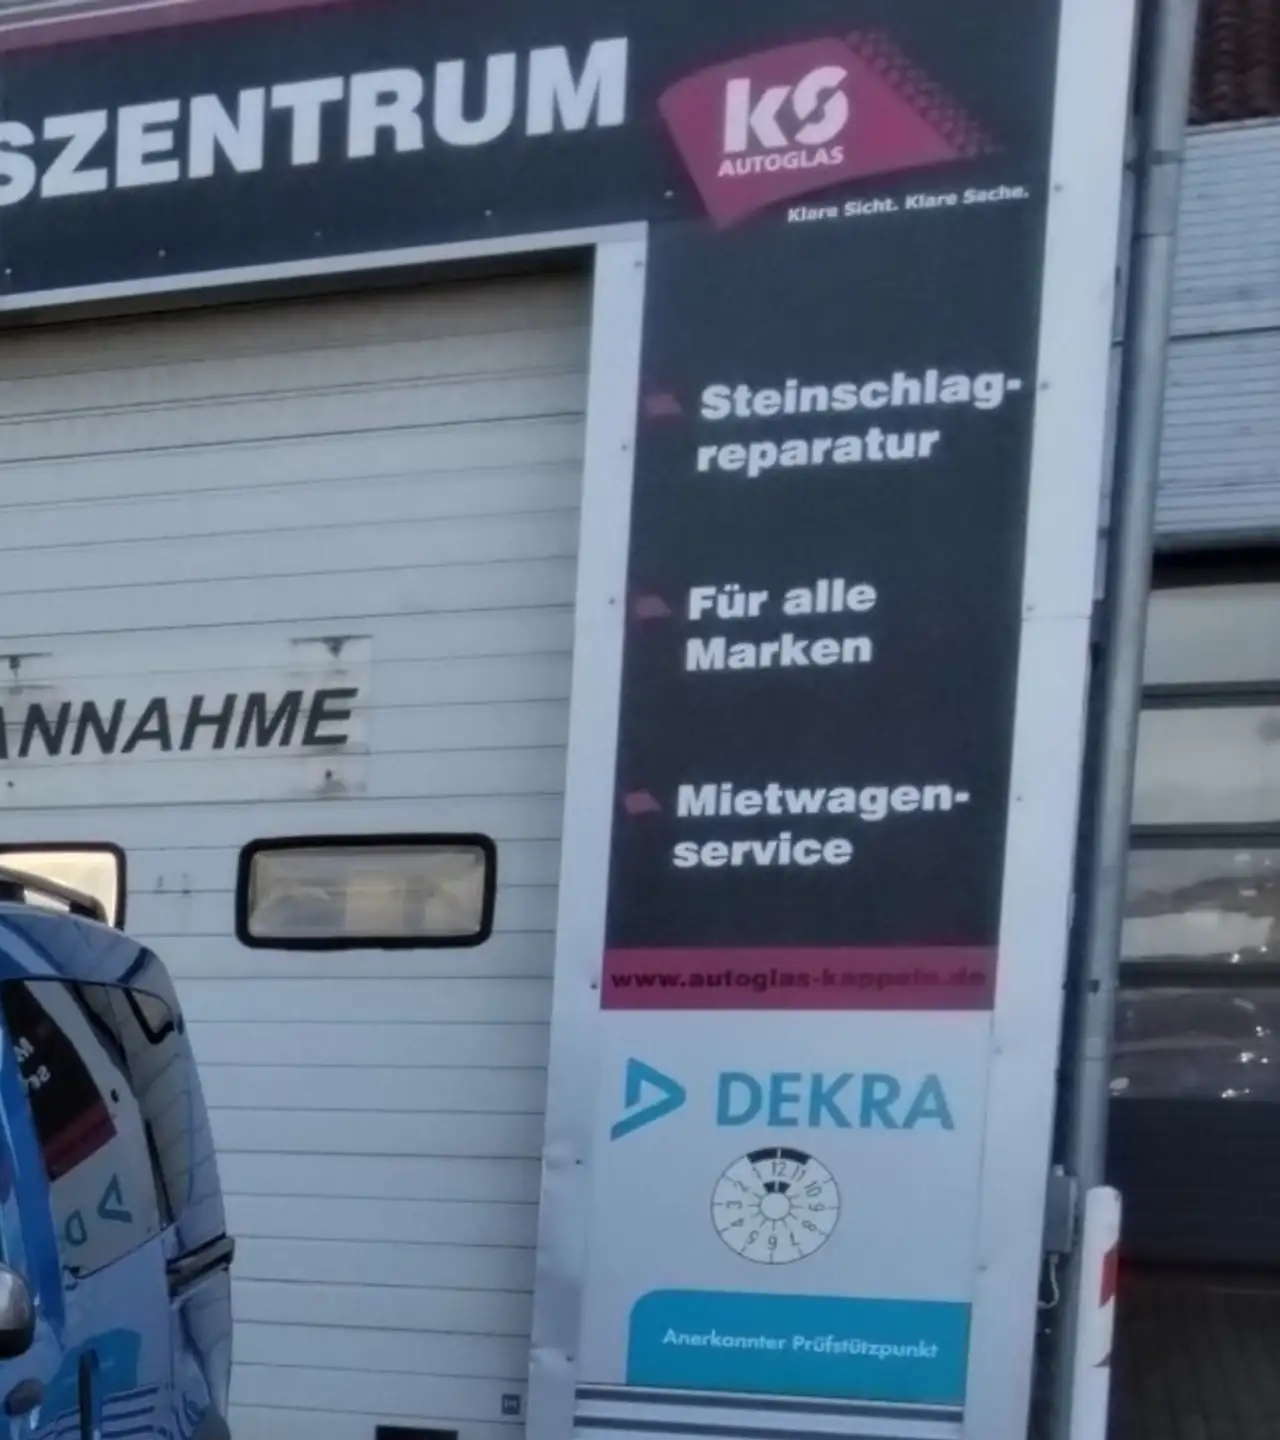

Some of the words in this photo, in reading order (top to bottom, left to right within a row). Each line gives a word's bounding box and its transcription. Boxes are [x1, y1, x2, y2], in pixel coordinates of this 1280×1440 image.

[717, 145, 845, 178] AUTOGLAS
[787, 206, 838, 222] Klare
[844, 198, 900, 217] Sicht.
[905, 193, 958, 210] Klare
[963, 184, 1030, 205] Sache.
[700, 368, 1023, 421] Steinschlag-
[695, 426, 941, 478] reparatur
[688, 584, 769, 622] Für
[783, 577, 878, 617] alle
[685, 632, 874, 672] Marken
[676, 782, 971, 822] Mietwagen-
[672, 831, 855, 868] service
[715, 1071, 956, 1131] DEKRA
[770, 1160, 789, 1178] 12
[662, 1327, 787, 1352] Anerkannter
[792, 1334, 939, 1361] Prüfstützpunkt
